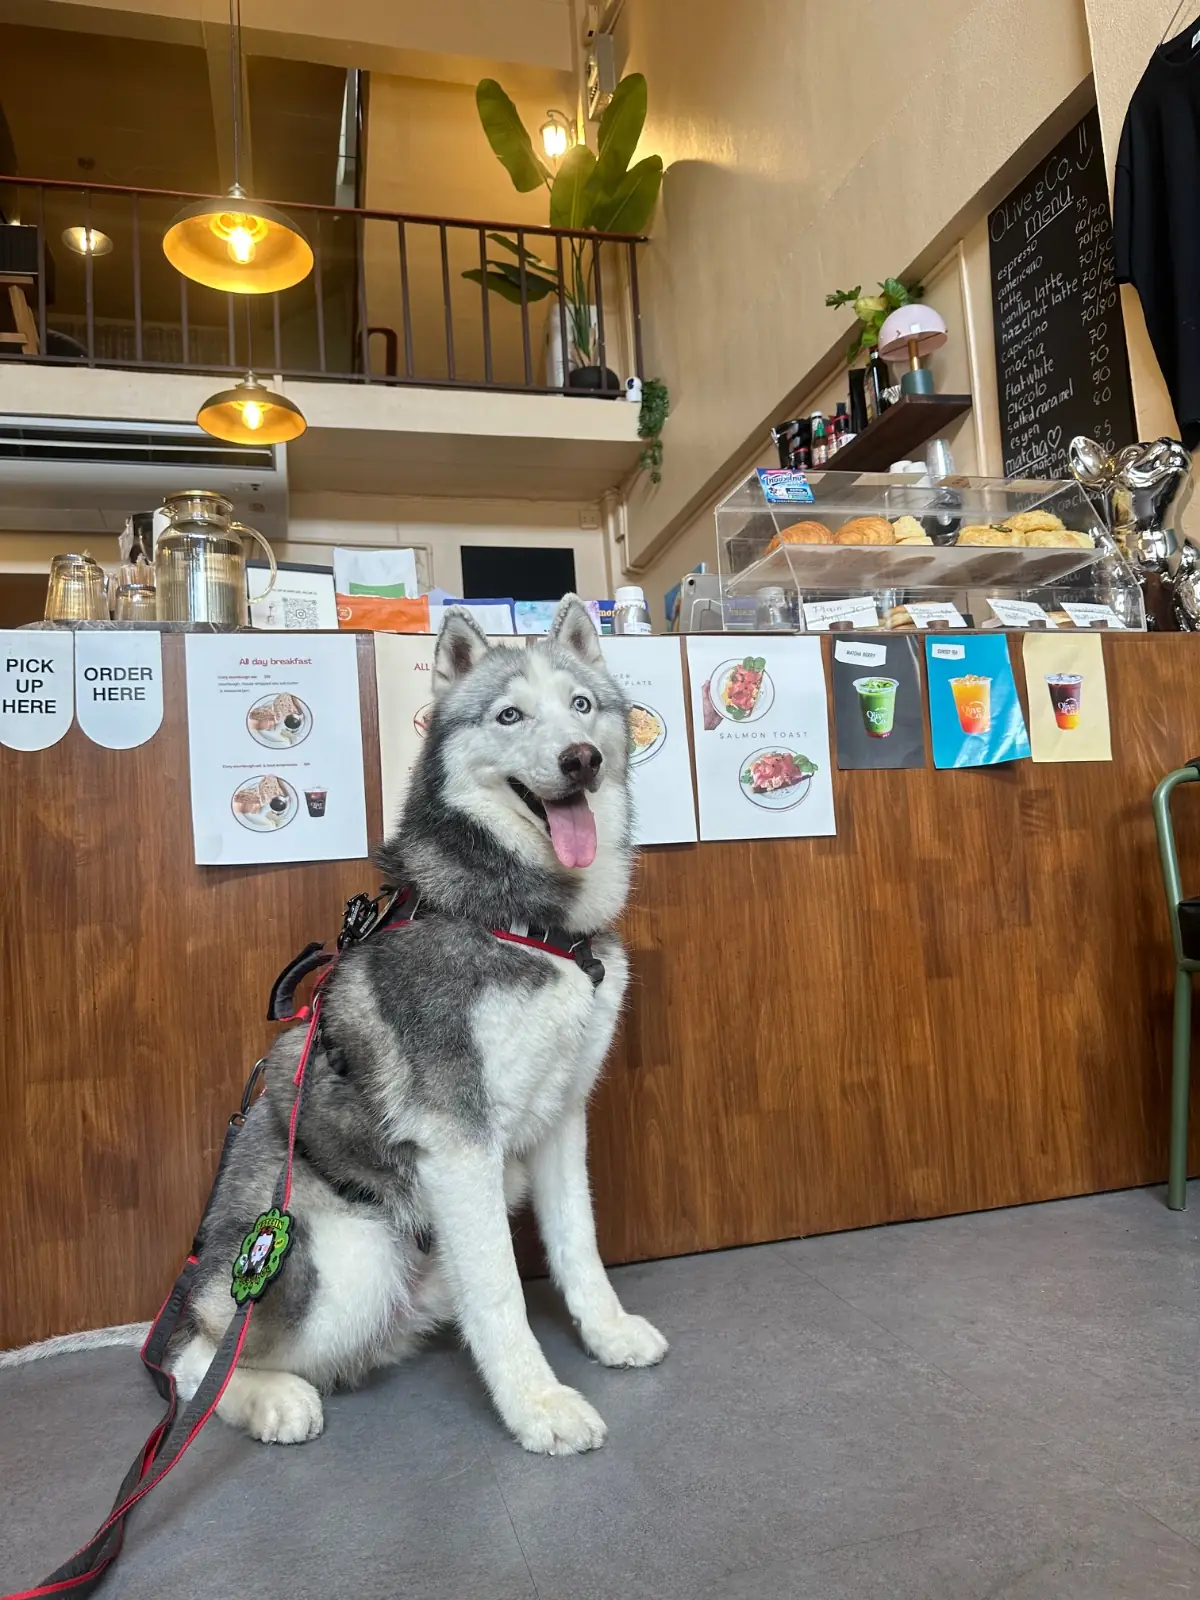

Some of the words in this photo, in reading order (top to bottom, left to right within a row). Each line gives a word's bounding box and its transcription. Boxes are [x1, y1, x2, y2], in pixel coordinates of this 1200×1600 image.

[997, 239, 1038, 280] espresso
[1000, 291, 1022, 314] latte
[1077, 220, 1109, 249] 70/80
[997, 255, 1043, 300] americano
[1001, 300, 1031, 329] vanilla
[1034, 272, 1064, 302] latte
[1001, 299, 1048, 344] hazelnut
[1051, 278, 1078, 306] latte
[1004, 342, 1045, 379] mocha
[1007, 382, 1047, 422] piccolo
[1005, 440, 1049, 475] matcha
[6, 658, 55, 673] PICK
[252, 658, 268, 666] day
[862, 650, 876, 658] BERRY
[84, 667, 153, 681] ORDER
[414, 663, 430, 671] ALL
[16, 679, 43, 693] UP
[93, 687, 146, 701] HERE
[2, 699, 57, 714] HERE
